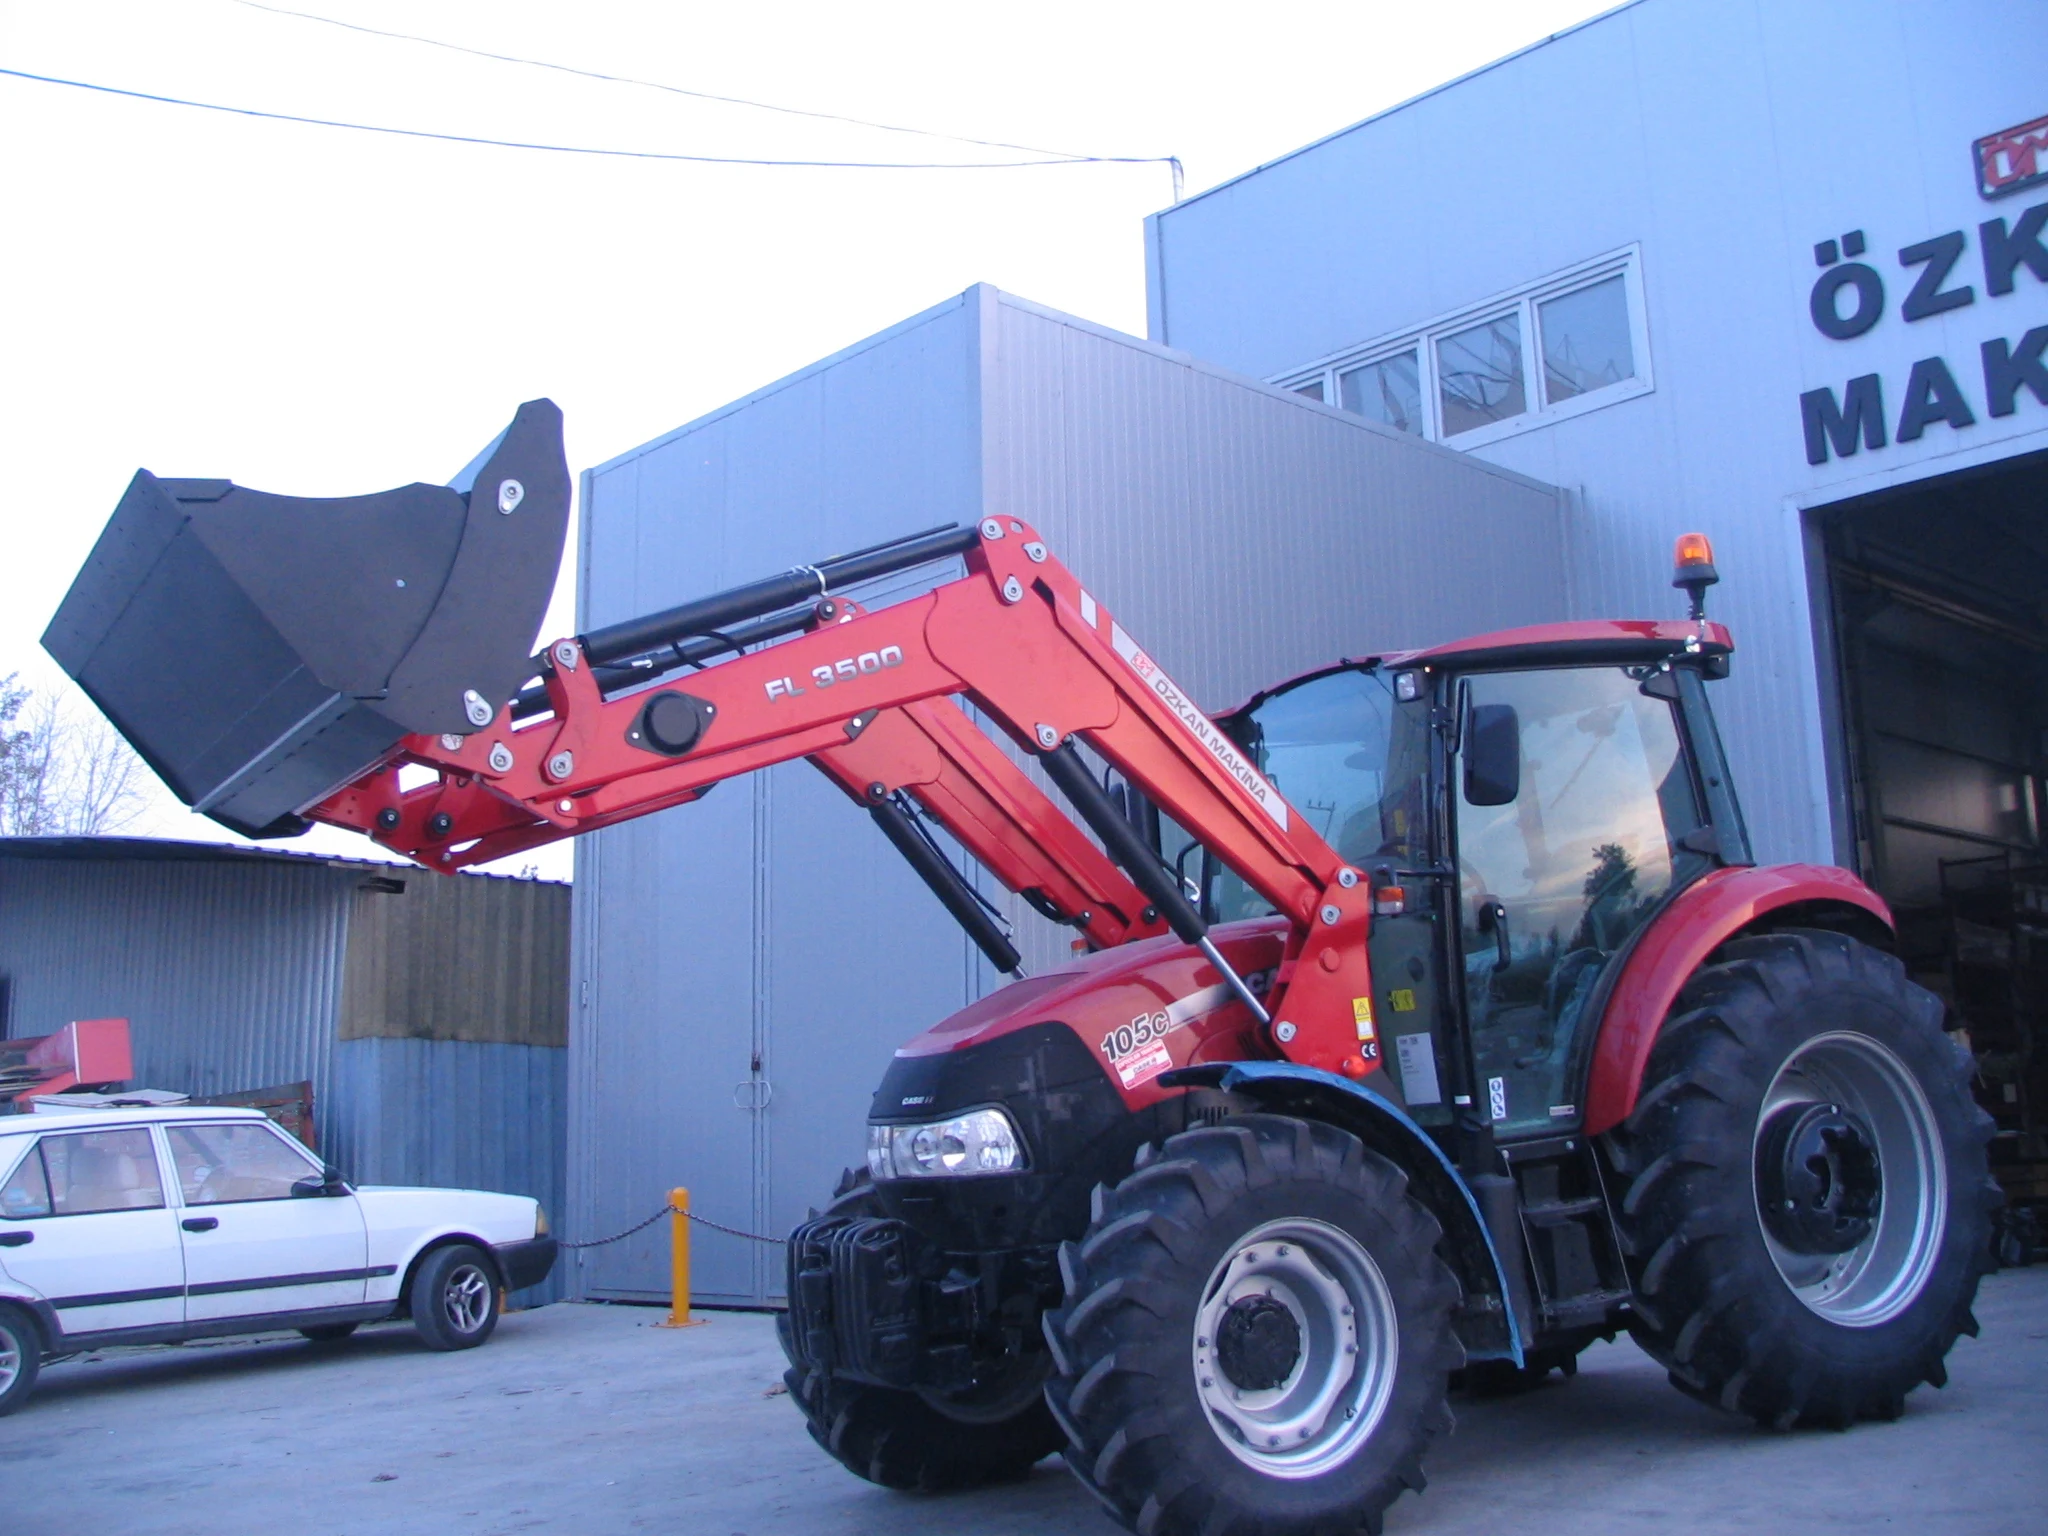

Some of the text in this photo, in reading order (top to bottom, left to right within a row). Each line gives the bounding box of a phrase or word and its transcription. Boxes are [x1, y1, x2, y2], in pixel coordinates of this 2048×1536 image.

[1810, 202, 2048, 341] ÖZK
[1800, 325, 2048, 465] MAK
[764, 645, 903, 703] FL 3500
[1155, 679, 1209, 739] ÖZKAN
[1361, 1042, 1377, 1058] CE
